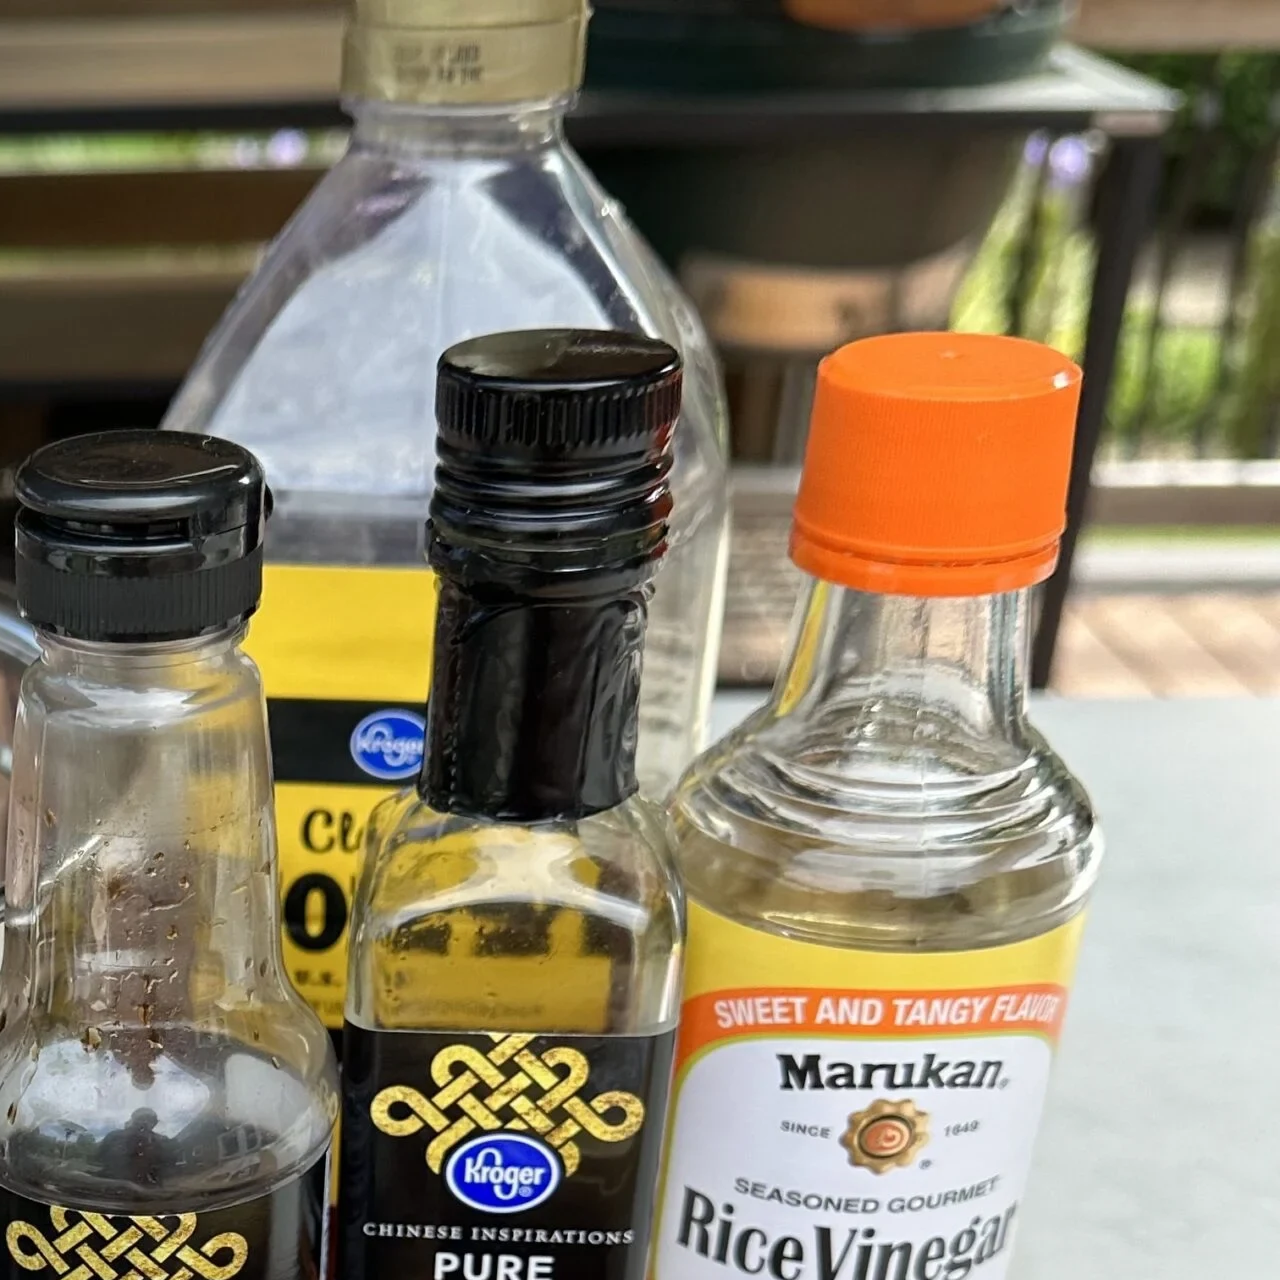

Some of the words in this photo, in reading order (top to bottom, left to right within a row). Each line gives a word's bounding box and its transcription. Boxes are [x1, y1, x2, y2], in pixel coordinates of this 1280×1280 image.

[714, 996, 808, 1028] SWEET
[815, 998, 882, 1026] AND
[892, 994, 986, 1026] TANGY
[776, 1053, 1002, 1091] Marukan
[780, 1119, 831, 1140] SINCE
[464, 1147, 546, 1199] Kroger
[733, 1177, 880, 1214] SEASONED
[887, 1174, 1002, 1214] GOURMET
[363, 1221, 462, 1241] CHINESE
[471, 1226, 635, 1246] INSPIRATIONS
